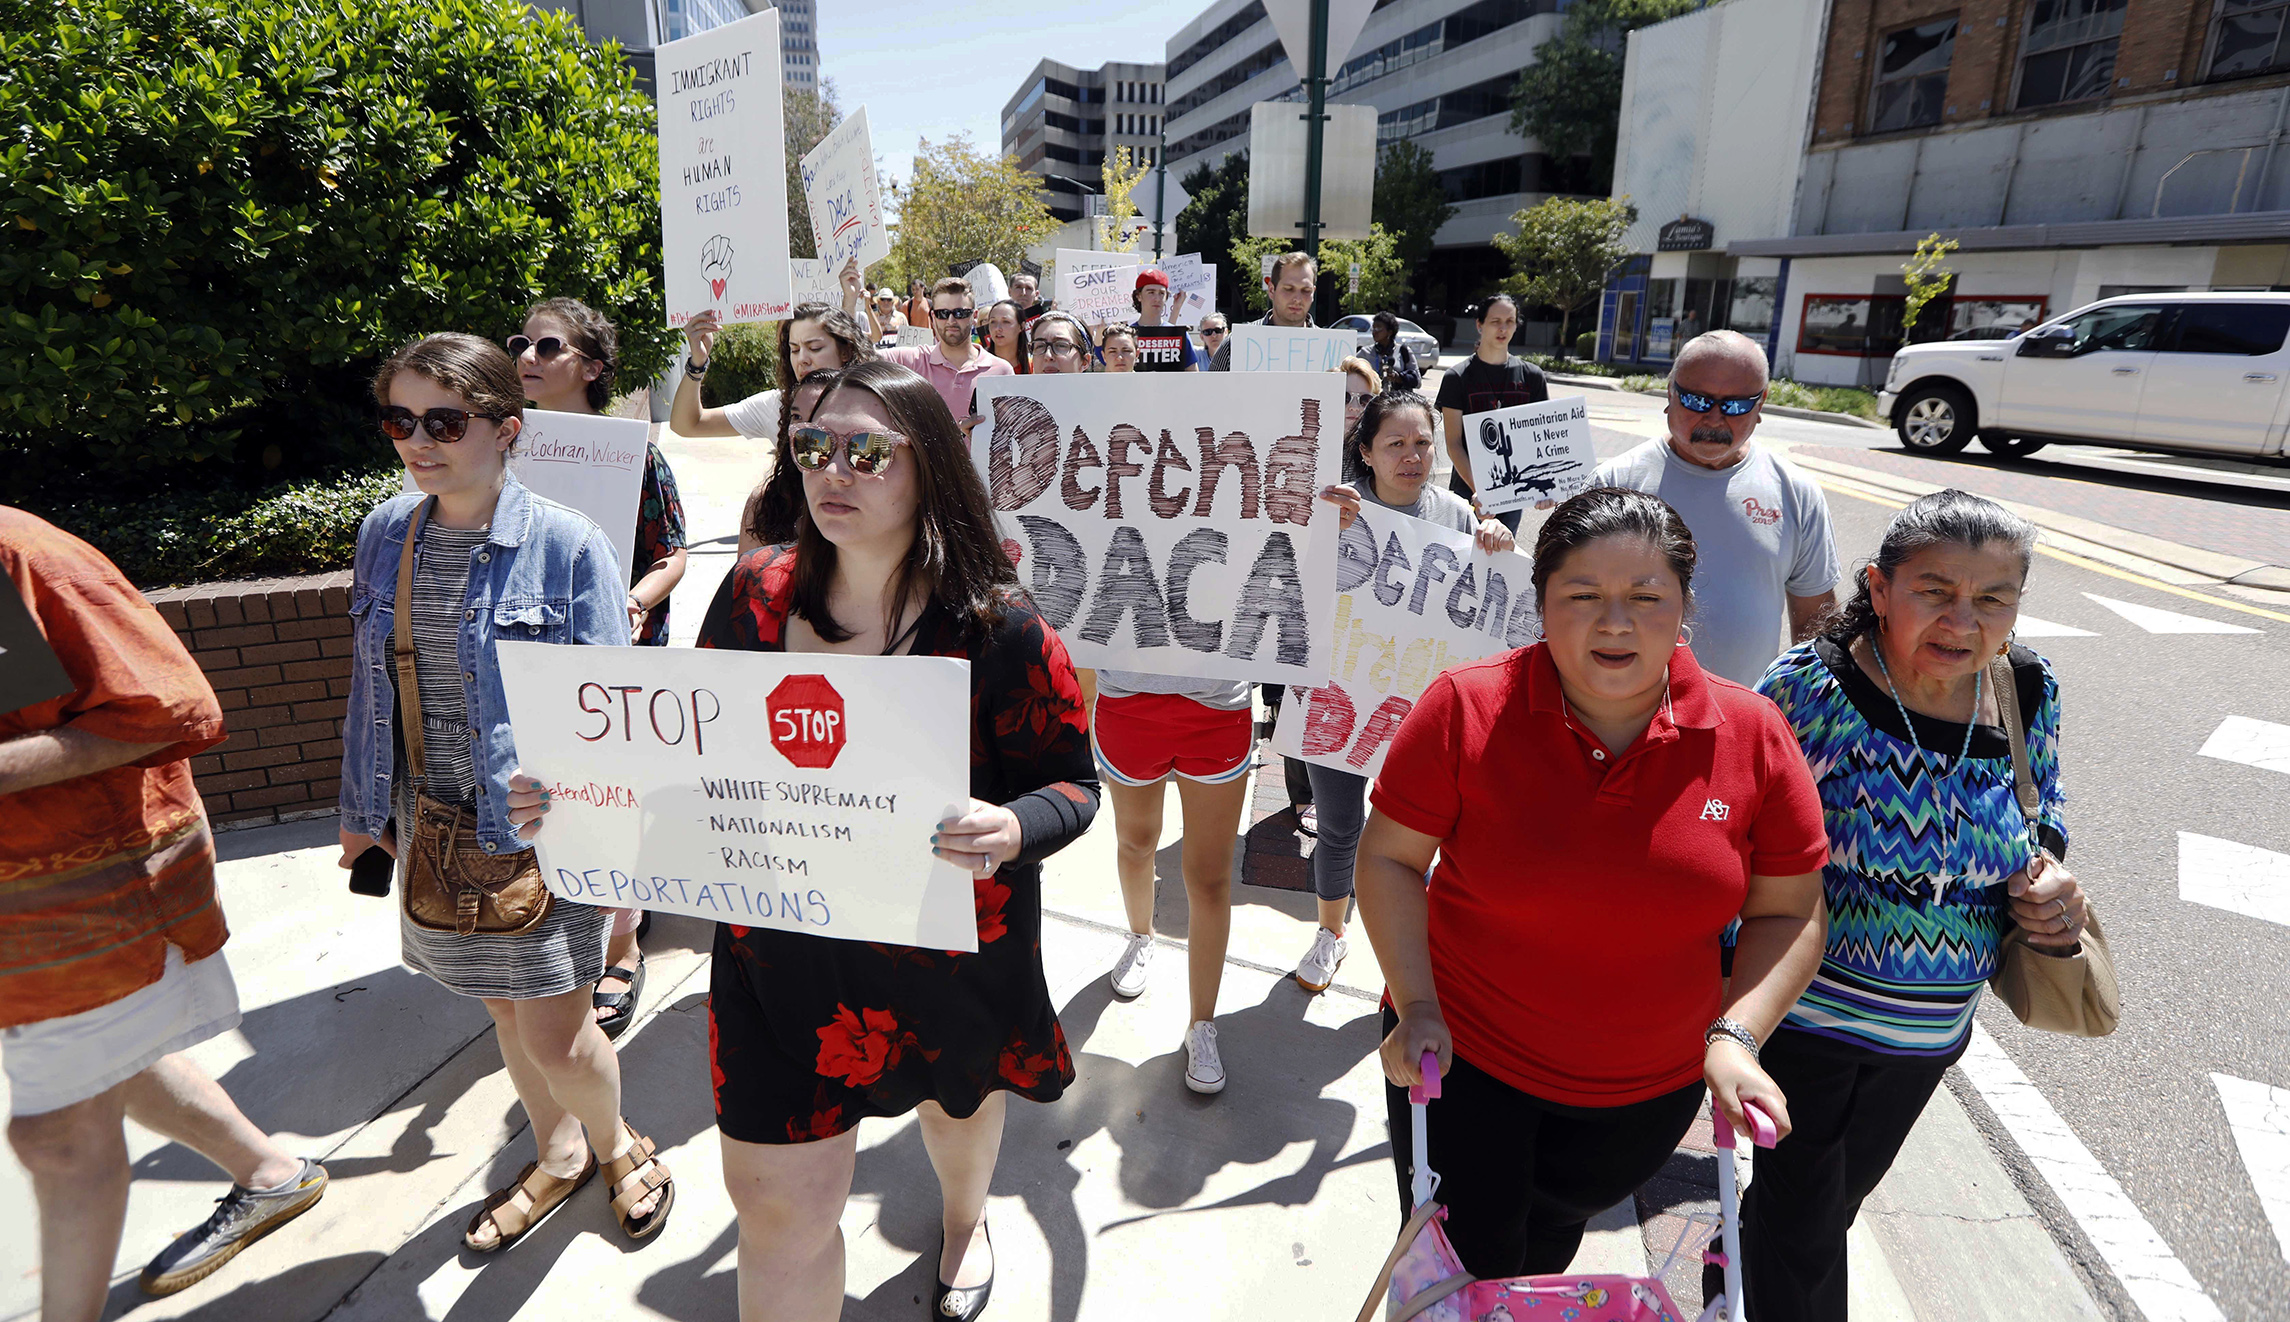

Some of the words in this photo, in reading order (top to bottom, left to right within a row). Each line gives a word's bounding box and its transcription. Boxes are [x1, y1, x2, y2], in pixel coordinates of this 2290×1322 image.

[671, 51, 752, 95] IMMIGRANT
[690, 89, 736, 123] RIGHTS
[697, 136, 715, 155] are
[683, 154, 731, 187] HUMAN
[695, 184, 742, 215] RIGHTS
[827, 189, 855, 234] DACA
[790, 261, 814, 279] WE
[824, 252, 834, 274] In
[1161, 259, 1195, 271] America
[1073, 269, 1117, 289] SAVE
[1090, 285, 1118, 297] OUR
[1077, 293, 1132, 310] DREAMER
[1091, 306, 1120, 320] NEED
[1135, 347, 1181, 363] TTER
[1138, 339, 1181, 348] DESERVE
[1508, 409, 1569, 431] Humanitarian
[1571, 405, 1585, 420] Aid
[530, 431, 590, 462] Cochran,
[591, 440, 640, 465] Wicker
[1533, 432, 1542, 443] Is
[1543, 428, 1569, 442] Never
[988, 395, 1322, 527] Defend
[1536, 448, 1544, 459] A
[1545, 443, 1570, 458] Crime
[1741, 497, 1784, 523] Prep
[1014, 514, 1311, 669] DACA
[575, 681, 721, 757] STOP
[773, 707, 840, 745] STOP
[775, 781, 897, 814] SUPREMACY
[556, 867, 832, 927] DEPORTATIONS
